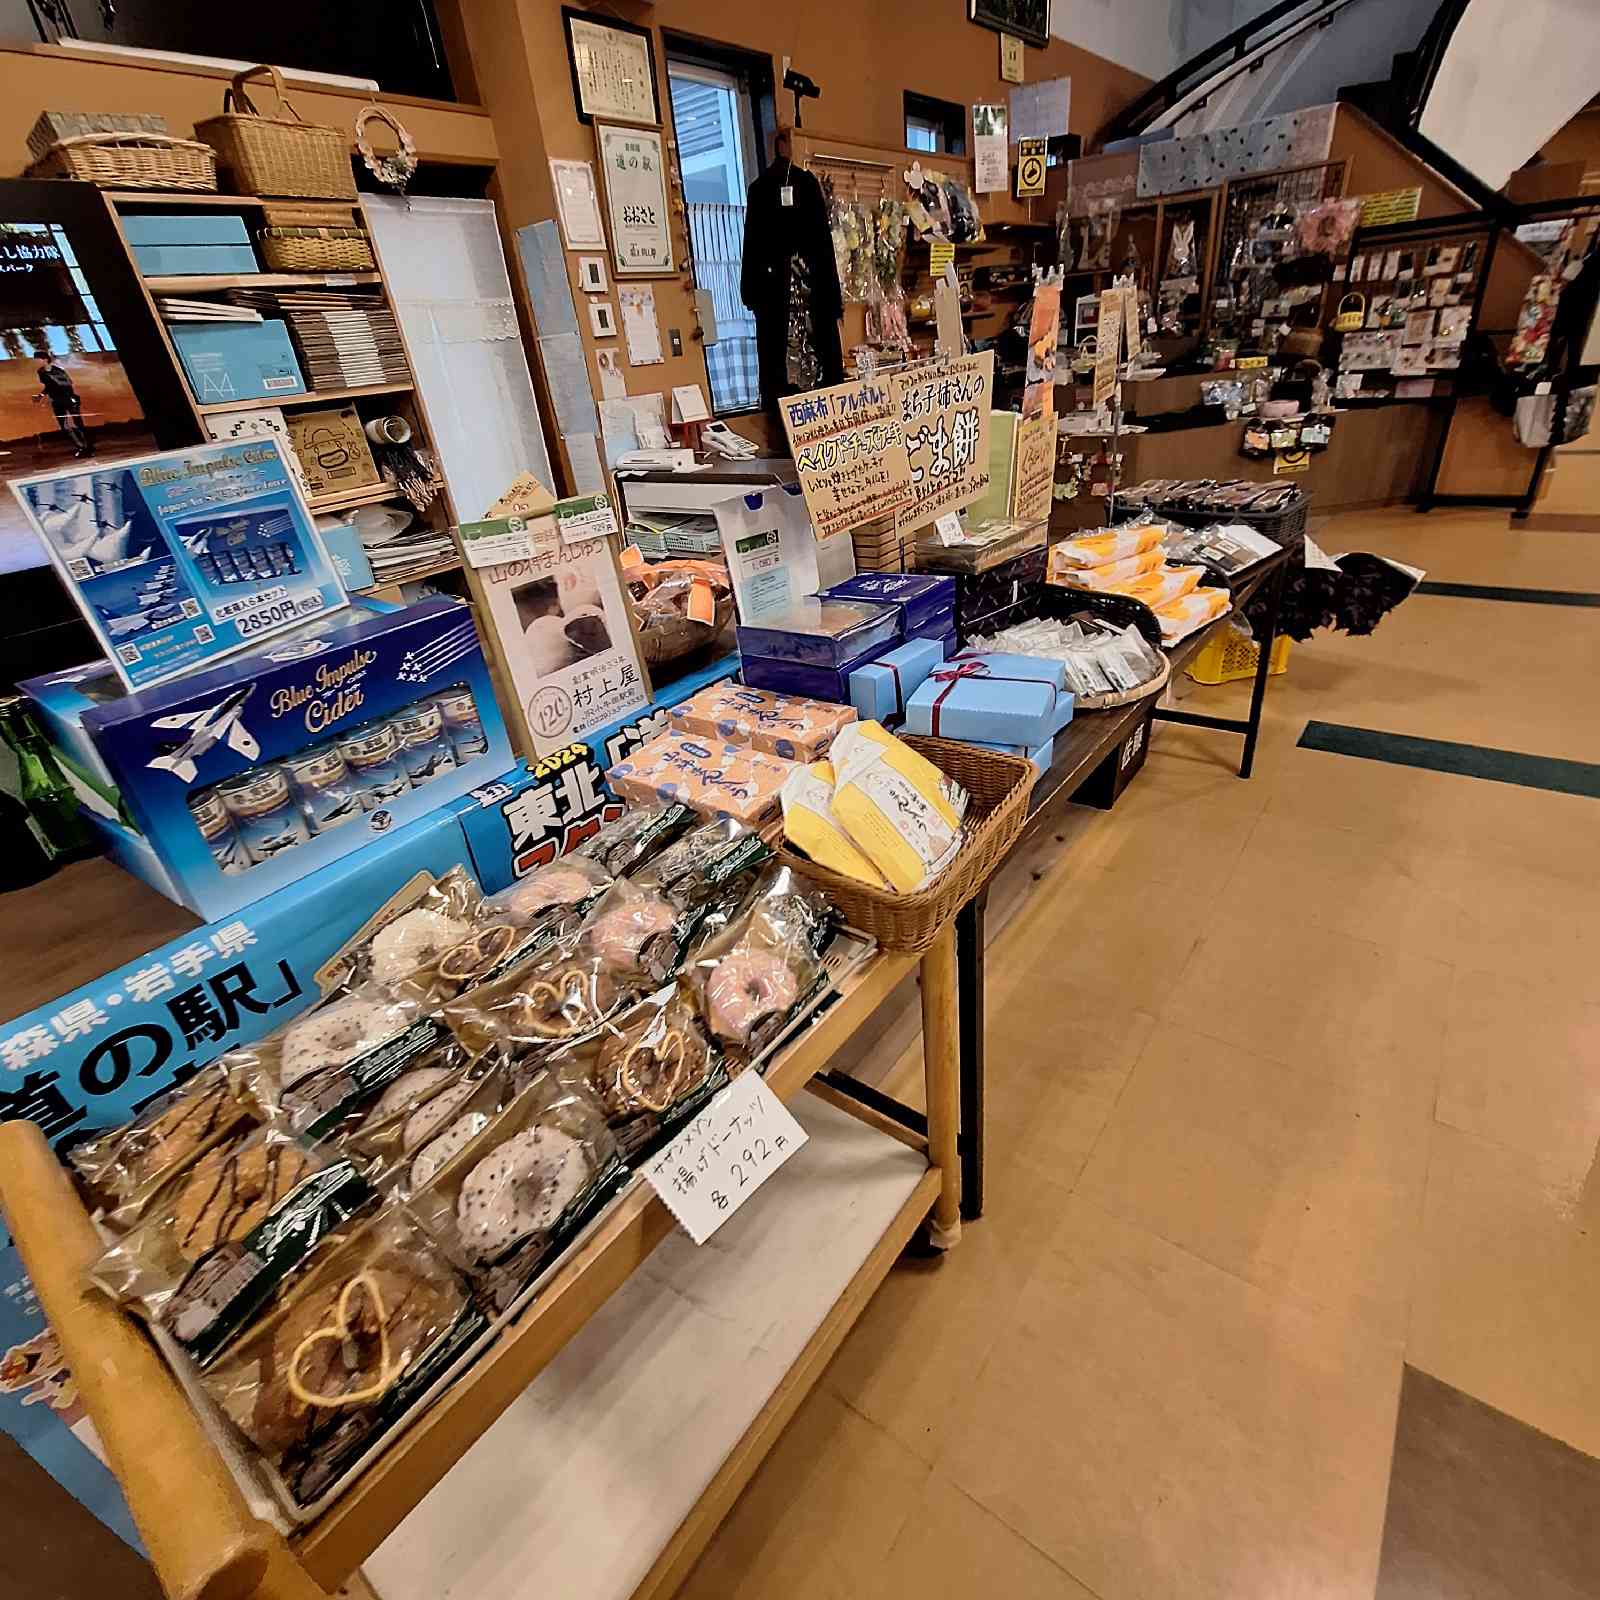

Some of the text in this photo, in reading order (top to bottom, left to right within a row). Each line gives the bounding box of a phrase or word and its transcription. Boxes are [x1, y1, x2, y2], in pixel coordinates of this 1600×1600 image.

[623, 205, 656, 225] おおさと
[0, 244, 60, 260] し協力隊
[901, 375, 985, 423] まち子姉さんの
[905, 407, 980, 484] ごま餅
[270, 649, 378, 733] Blue Impulse Cider
[573, 663, 640, 708] 村上屋
[528, 742, 589, 779] 2024
[503, 760, 606, 850] 東北
